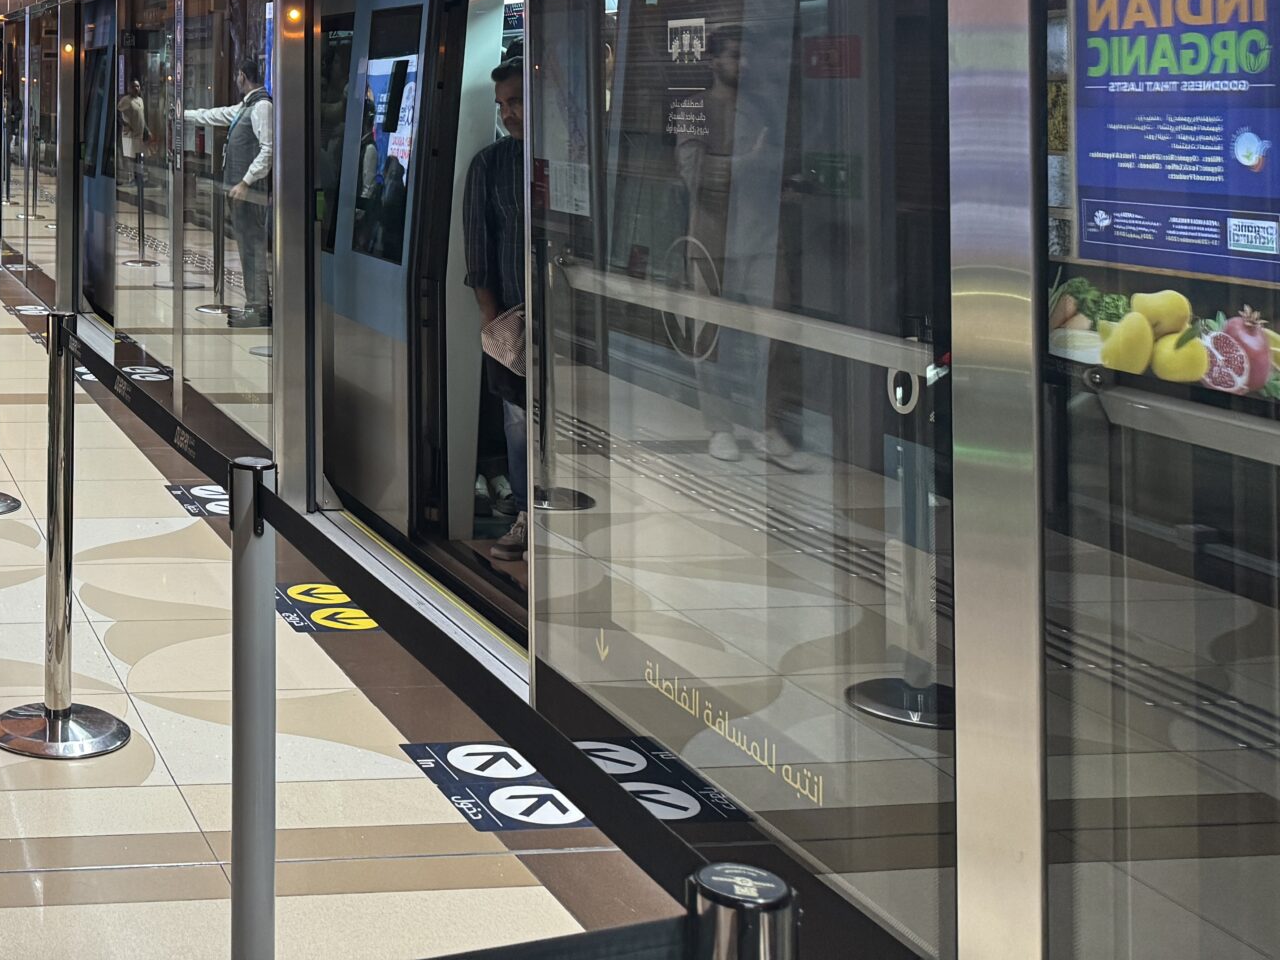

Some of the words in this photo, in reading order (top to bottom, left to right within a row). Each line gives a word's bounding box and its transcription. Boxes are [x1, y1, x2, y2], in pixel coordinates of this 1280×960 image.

[644, 660, 699, 718] الفاصلة
[703, 701, 776, 774] للمسافة
[450, 794, 483, 821] دخول
[782, 764, 822, 806] انتبه
